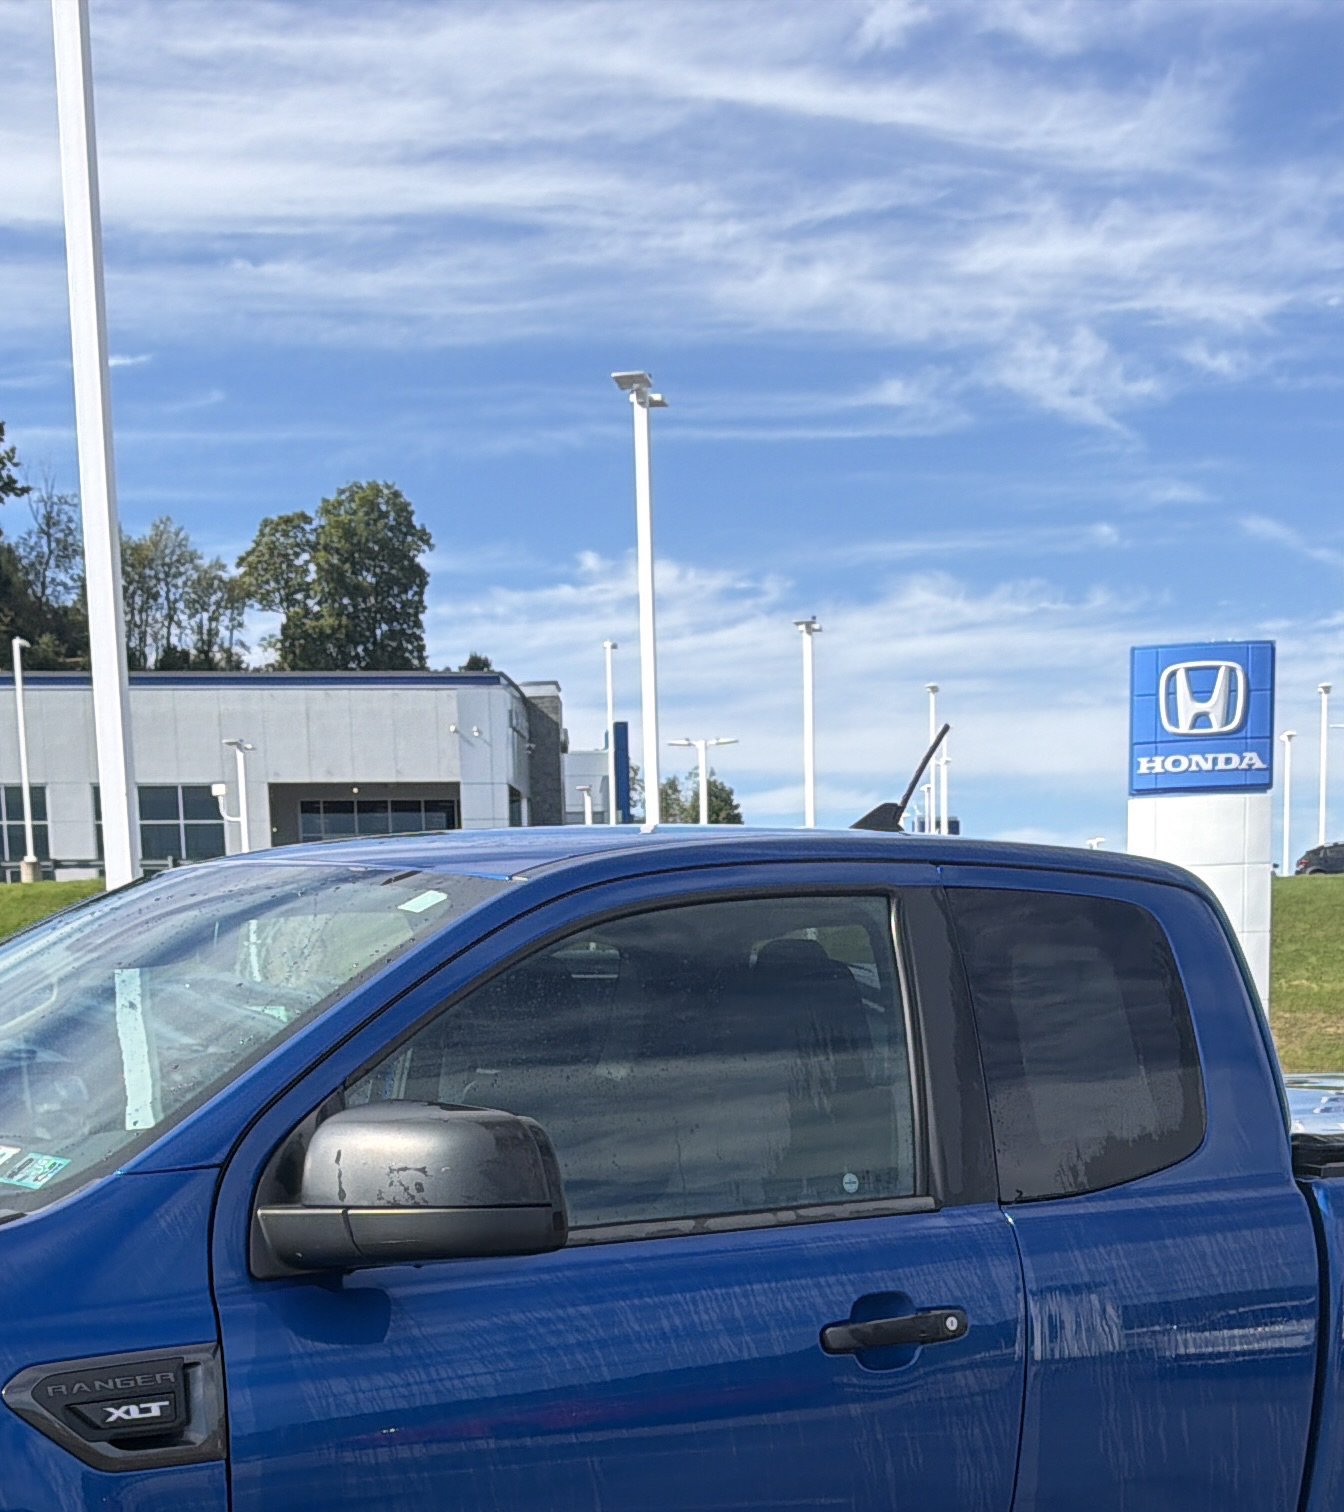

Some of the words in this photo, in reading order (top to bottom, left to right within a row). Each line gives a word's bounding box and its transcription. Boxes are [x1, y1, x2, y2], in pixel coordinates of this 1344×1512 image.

[1136, 752, 1268, 774] HONDA
[47, 1372, 176, 1398] RANGER
[102, 1400, 170, 1423] XLT
